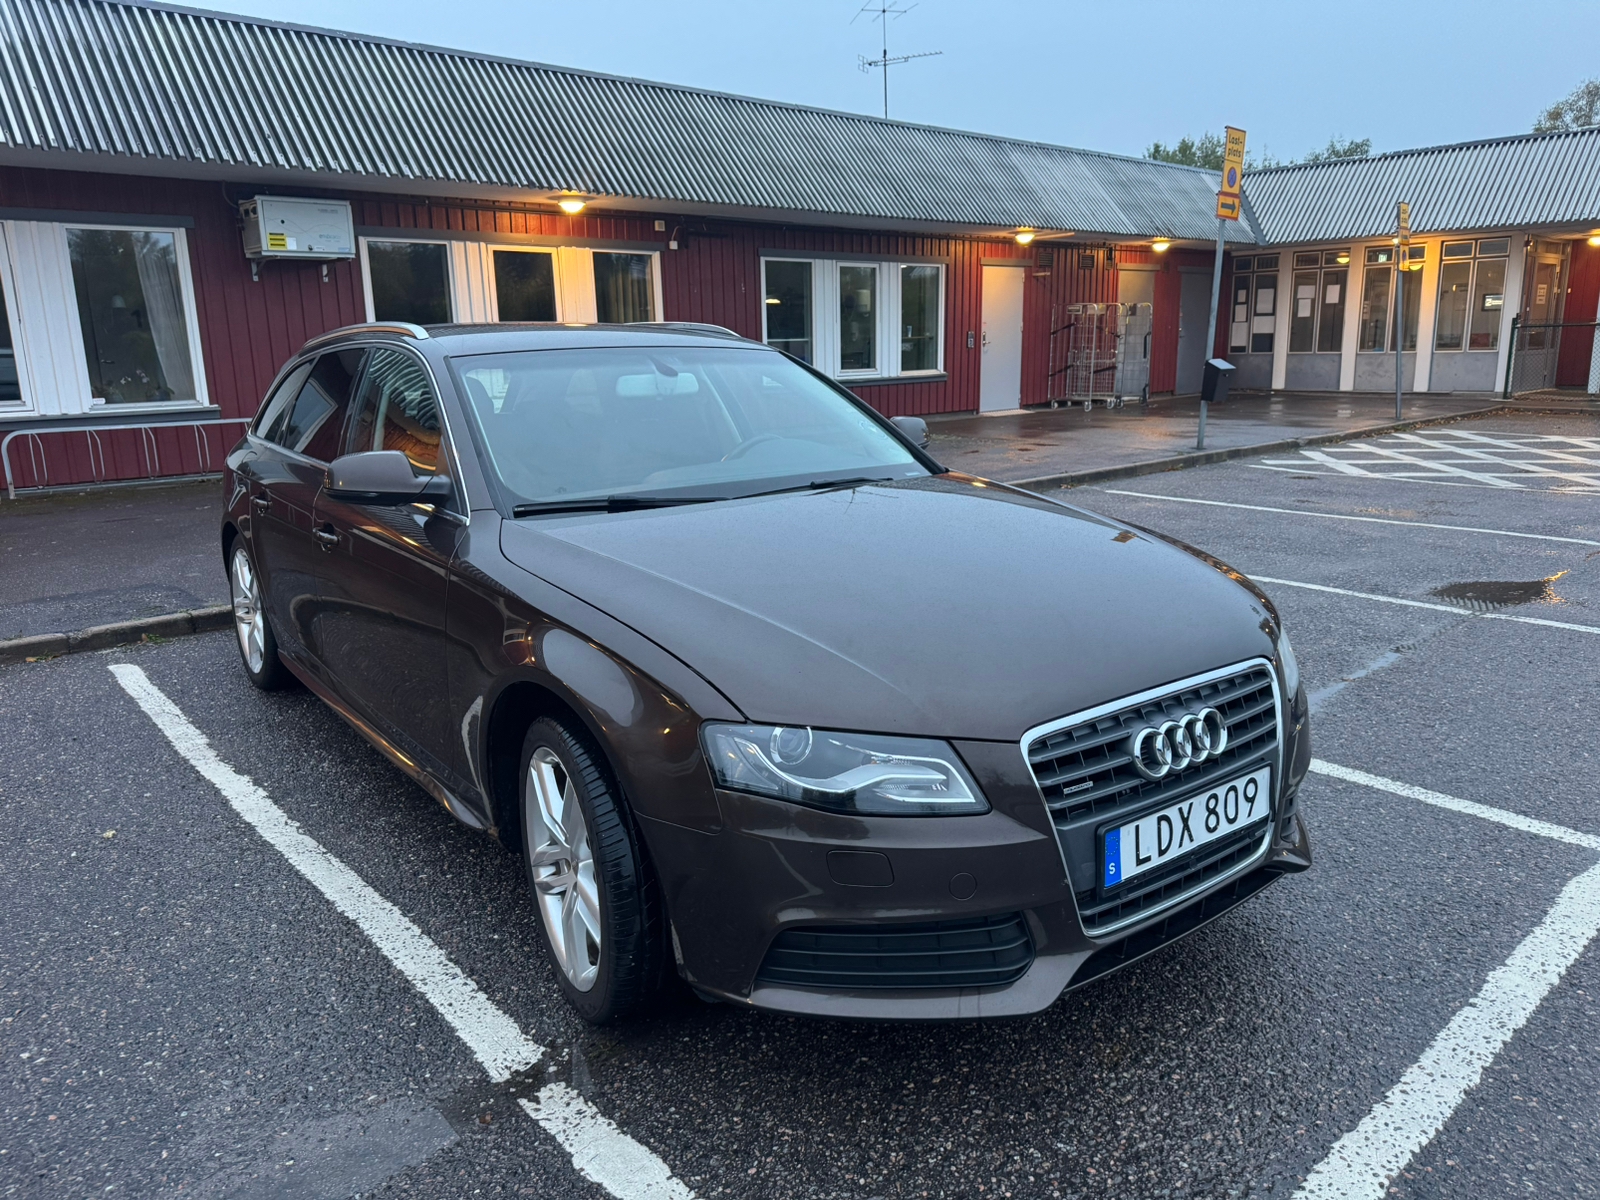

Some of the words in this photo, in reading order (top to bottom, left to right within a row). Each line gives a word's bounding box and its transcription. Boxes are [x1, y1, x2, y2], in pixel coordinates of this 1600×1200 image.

[1228, 133, 1243, 146] Last-
[1227, 146, 1242, 158] plats
[1134, 801, 1195, 867] LDX
[1204, 776, 1259, 834] 809
[1108, 862, 1116, 875] S
